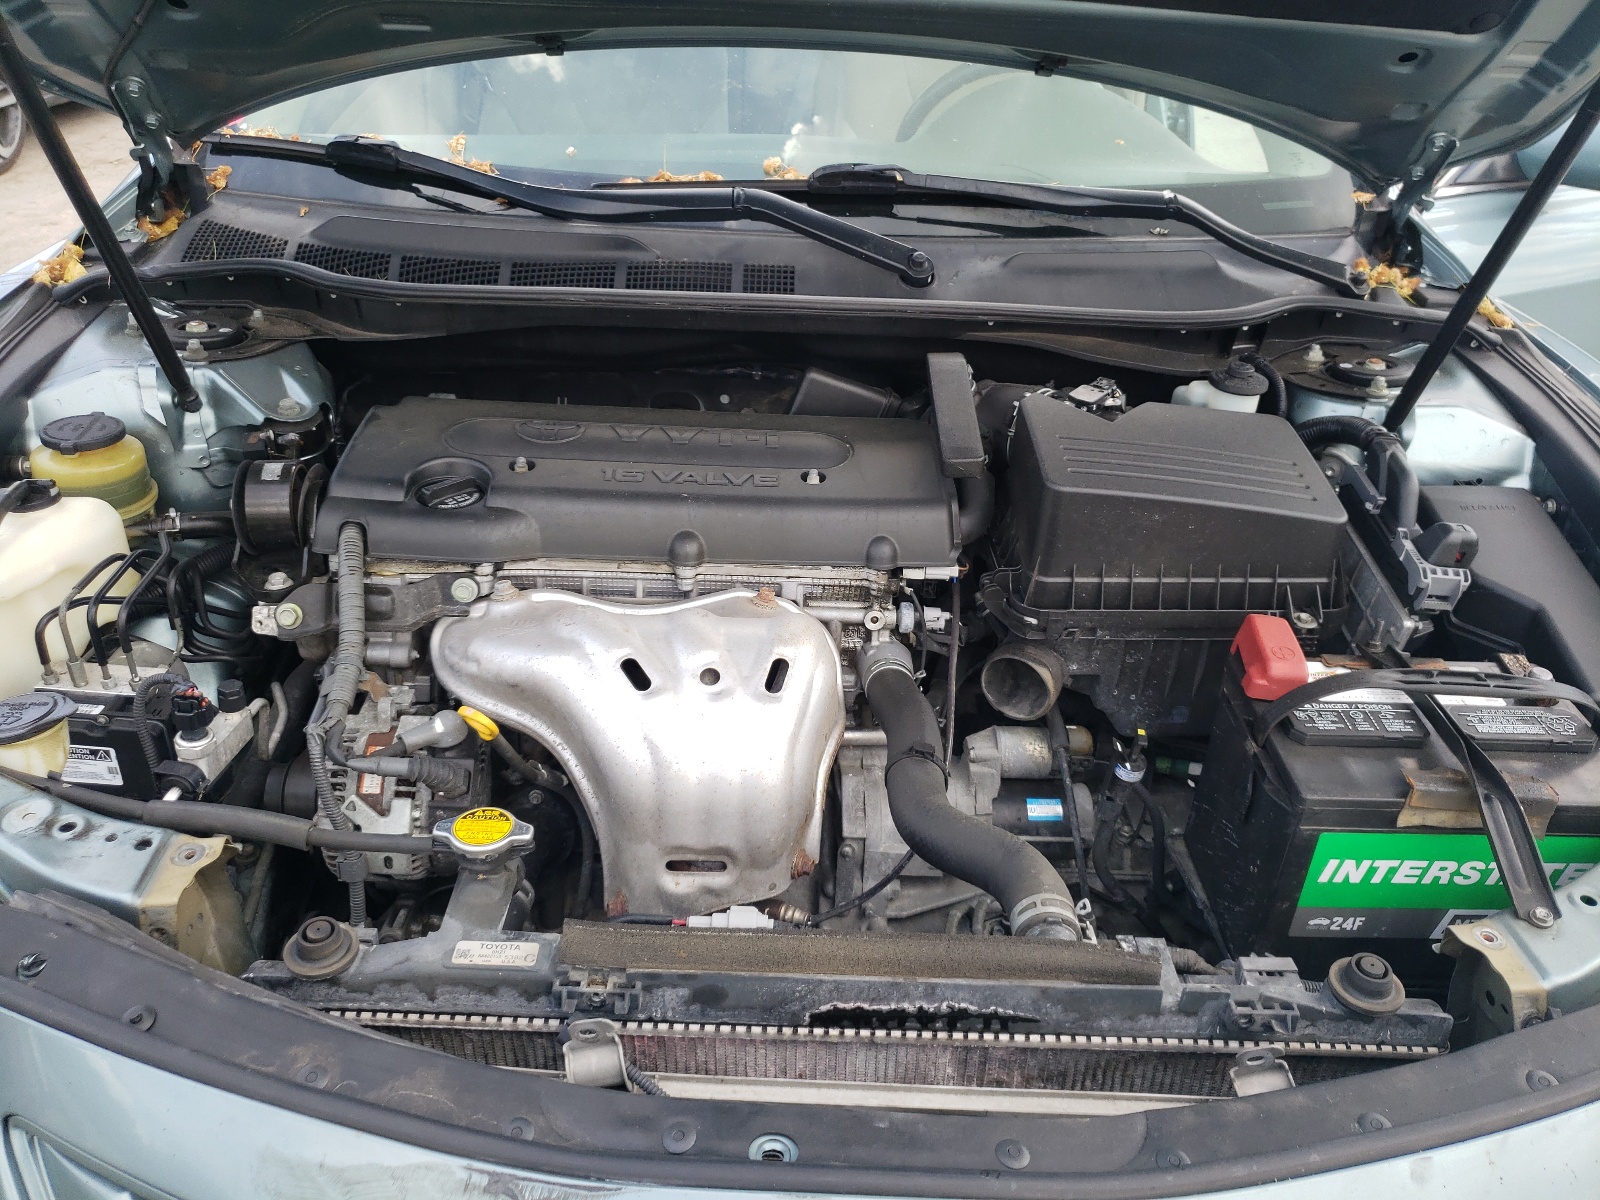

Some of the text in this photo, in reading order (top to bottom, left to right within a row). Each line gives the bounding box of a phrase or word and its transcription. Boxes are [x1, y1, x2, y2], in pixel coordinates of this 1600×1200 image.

[602, 468, 780, 487] 16 VALVE
[1317, 859, 1595, 887] INTERSTTE
[1329, 916, 1366, 931] 24F
